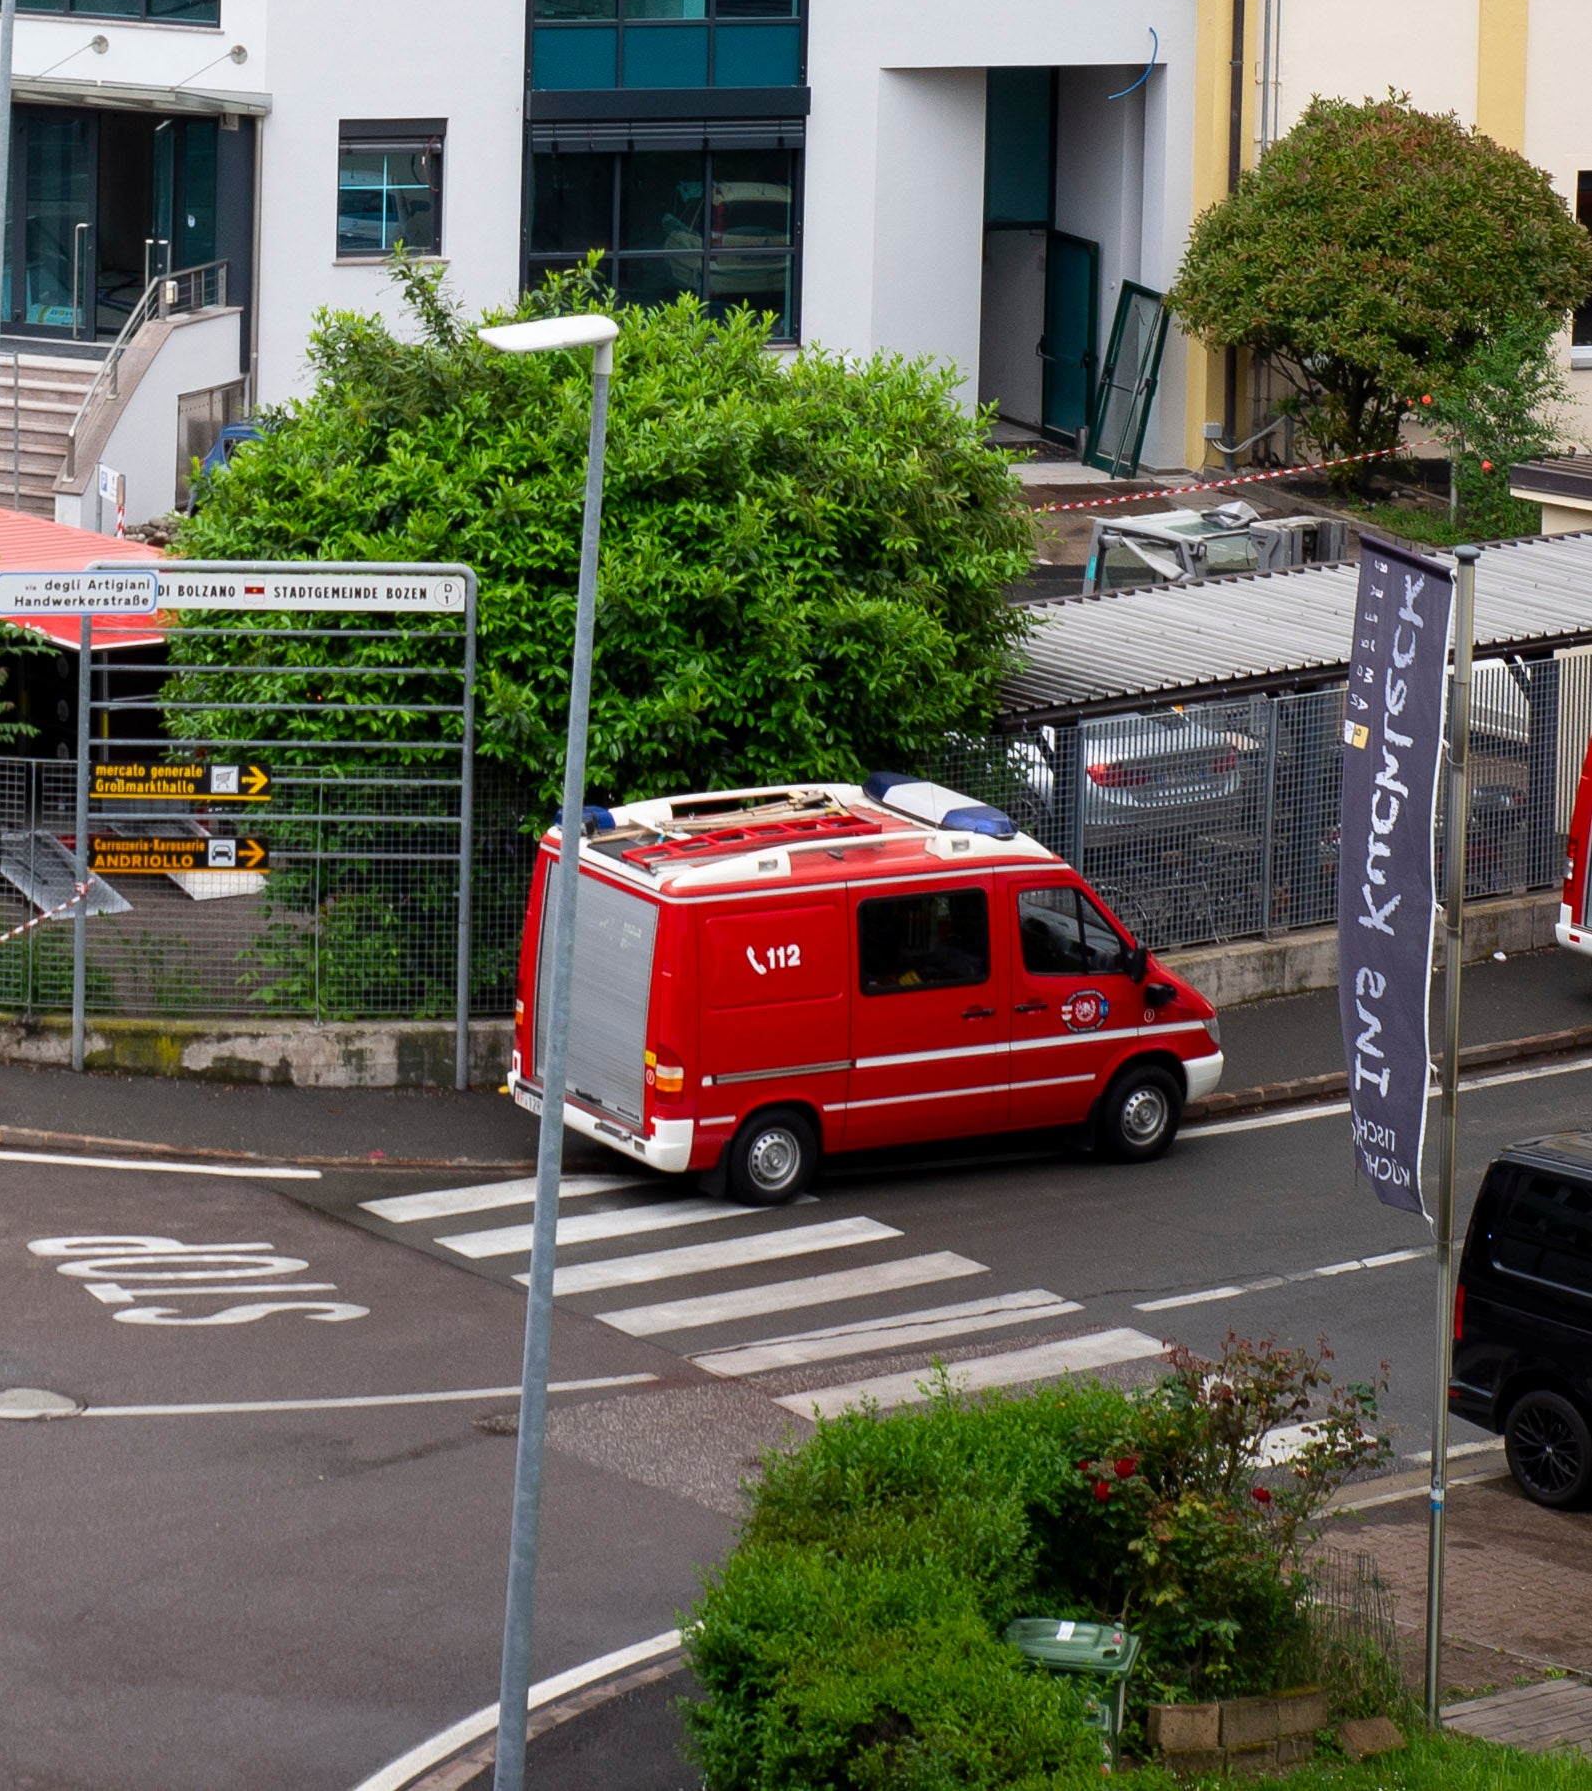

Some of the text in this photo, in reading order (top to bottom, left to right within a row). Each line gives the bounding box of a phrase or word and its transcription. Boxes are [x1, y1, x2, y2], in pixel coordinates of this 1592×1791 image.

[25, 579, 151, 594] via degli Artigiani
[158, 585, 428, 600] DI BOLZANO STADTGEMEINDE BOZEN
[444, 583, 453, 593] D
[14, 594, 150, 609] Handwerkerstraße
[95, 764, 203, 779] mercato generale
[95, 779, 195, 794] Großmarkthalle
[93, 854, 194, 868] ANDRIOLLO
[766, 944, 801, 970] 112
[27, 1234, 371, 1326] STOP
